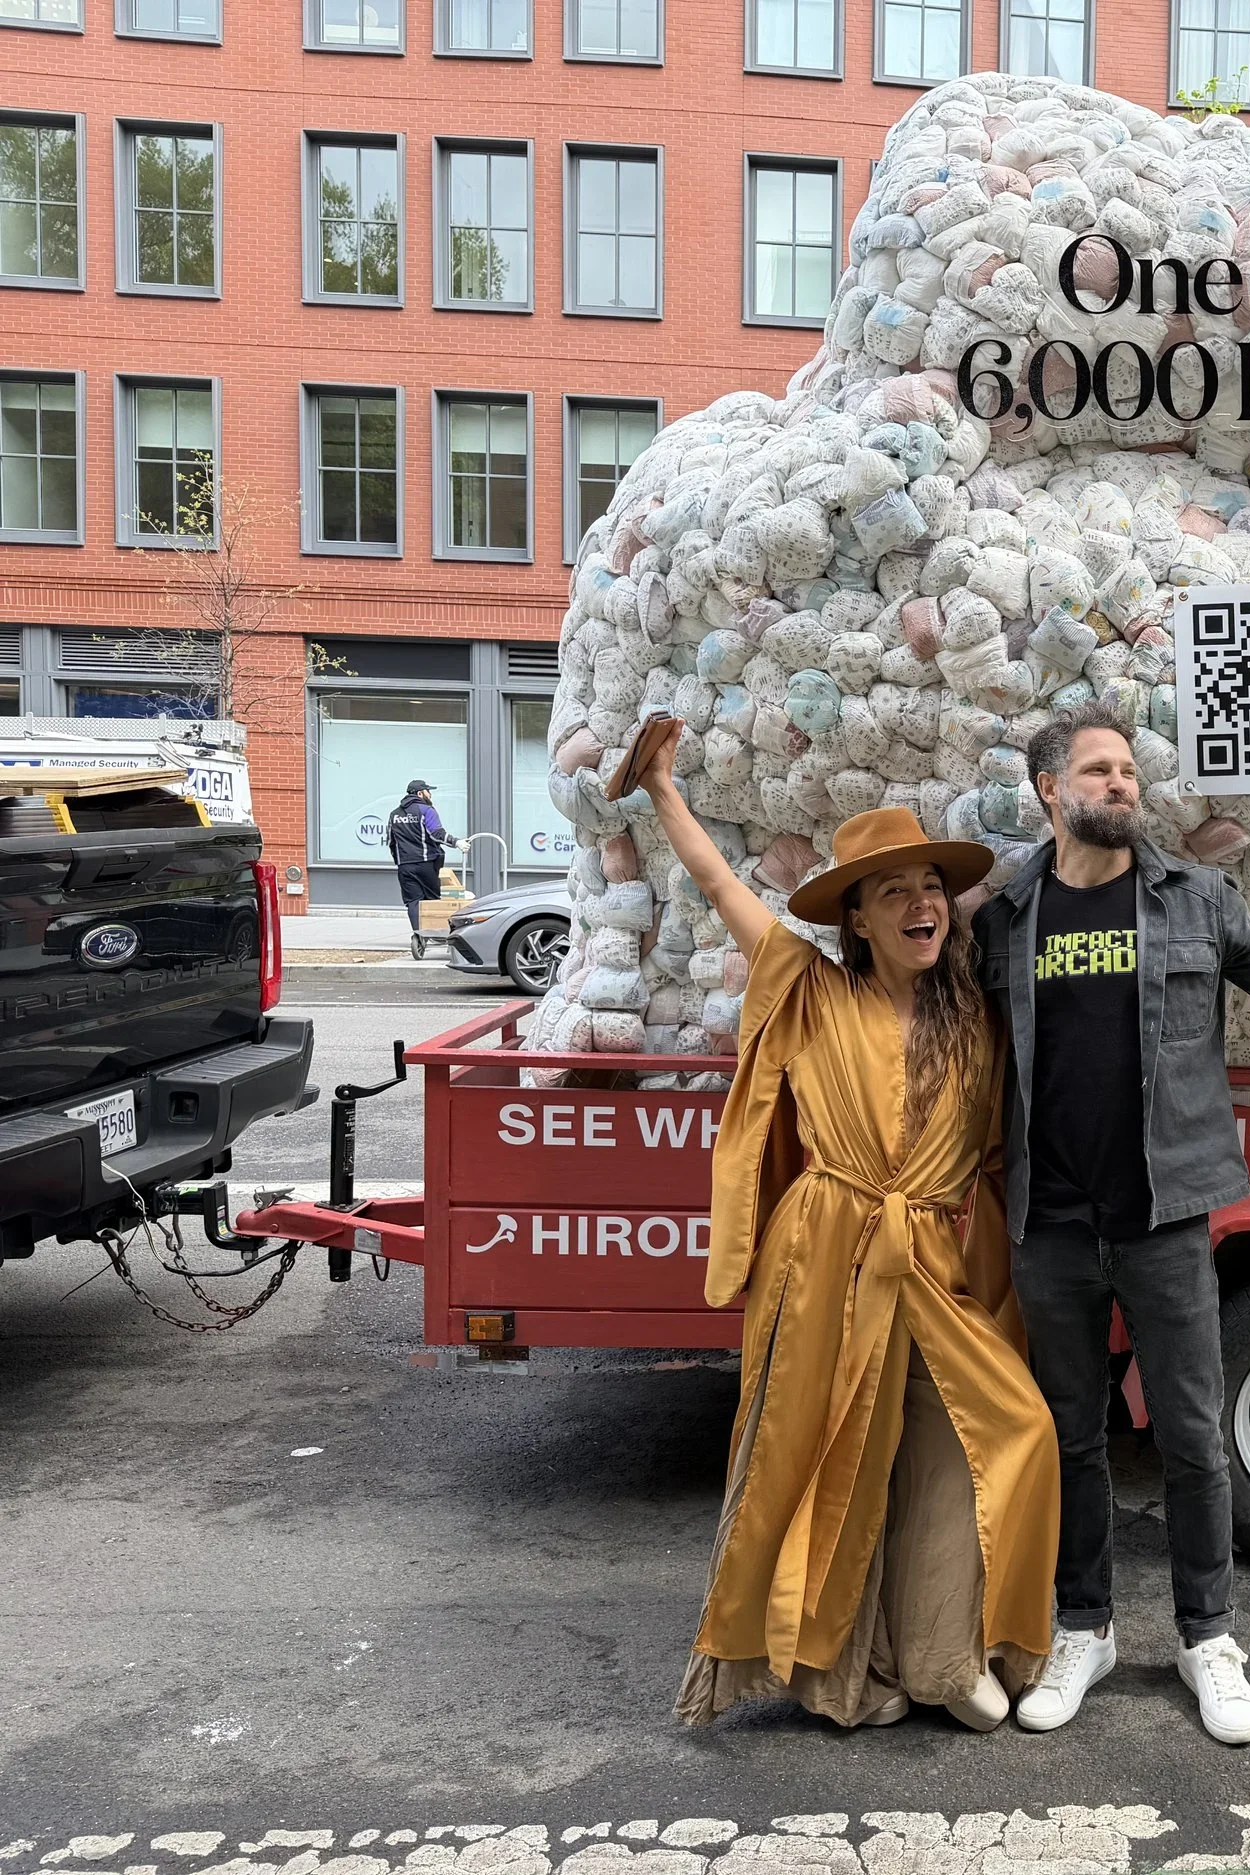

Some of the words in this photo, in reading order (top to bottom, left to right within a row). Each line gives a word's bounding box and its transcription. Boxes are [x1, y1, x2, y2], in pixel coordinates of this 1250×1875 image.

[1058, 233, 1244, 316] One
[957, 339, 1219, 435] 6,000
[49, 758, 96, 768] Managed
[99, 759, 139, 769] Security
[197, 769, 232, 801] DGA
[203, 802, 234, 821] Security
[361, 824, 383, 835] NYU
[554, 833, 571, 841] NYU
[554, 841, 576, 852] Car
[98, 932, 128, 955] Ford
[1045, 930, 1137, 954] IMPACT
[1034, 947, 1137, 981] ARCAD
[0, 975, 125, 1022] PER
[101, 1107, 134, 1142] 5580
[498, 1103, 617, 1147] SEE
[635, 1107, 721, 1149] WH
[101, 1143, 113, 1153] EET
[532, 1215, 712, 1257] HIROD
